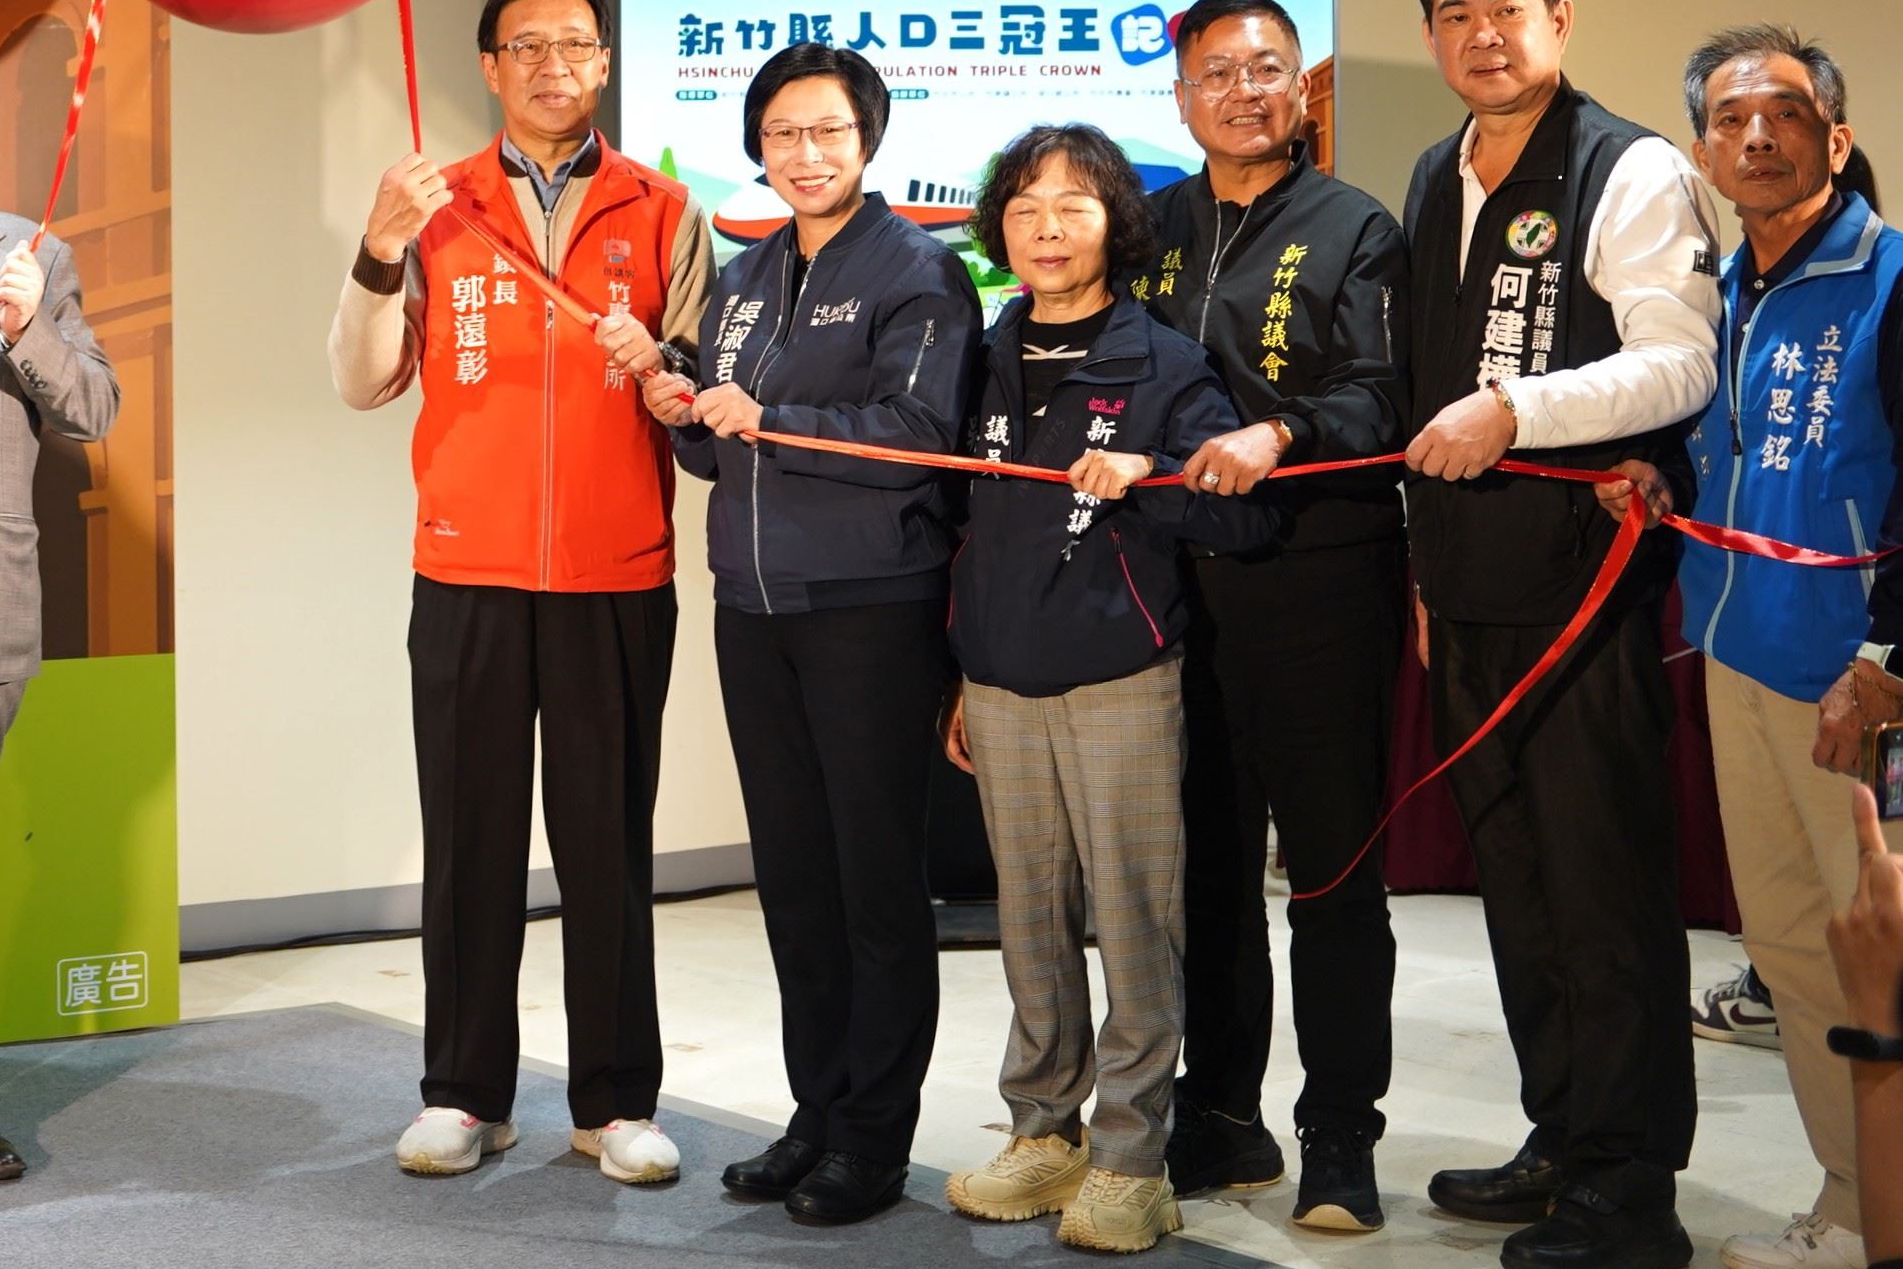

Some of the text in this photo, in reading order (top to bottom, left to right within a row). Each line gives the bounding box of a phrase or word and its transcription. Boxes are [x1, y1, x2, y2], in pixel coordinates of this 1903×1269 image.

[677, 4, 1100, 57] 新竹縣人口三冠王
[678, 66, 754, 78] HSINCHU
[970, 65, 1028, 77] TRIPLE
[1039, 64, 1102, 77] CROWN
[1156, 246, 1184, 296] 議員
[1260, 243, 1309, 382] 新竹縣議會
[1529, 260, 1562, 375] 新竹縣議員
[451, 275, 488, 385] 郭遠彰
[715, 301, 765, 383] 吳淑君
[1760, 341, 1807, 472] 林思銘
[1803, 324, 1843, 449] 立法委員
[65, 958, 143, 1008] 廣告
